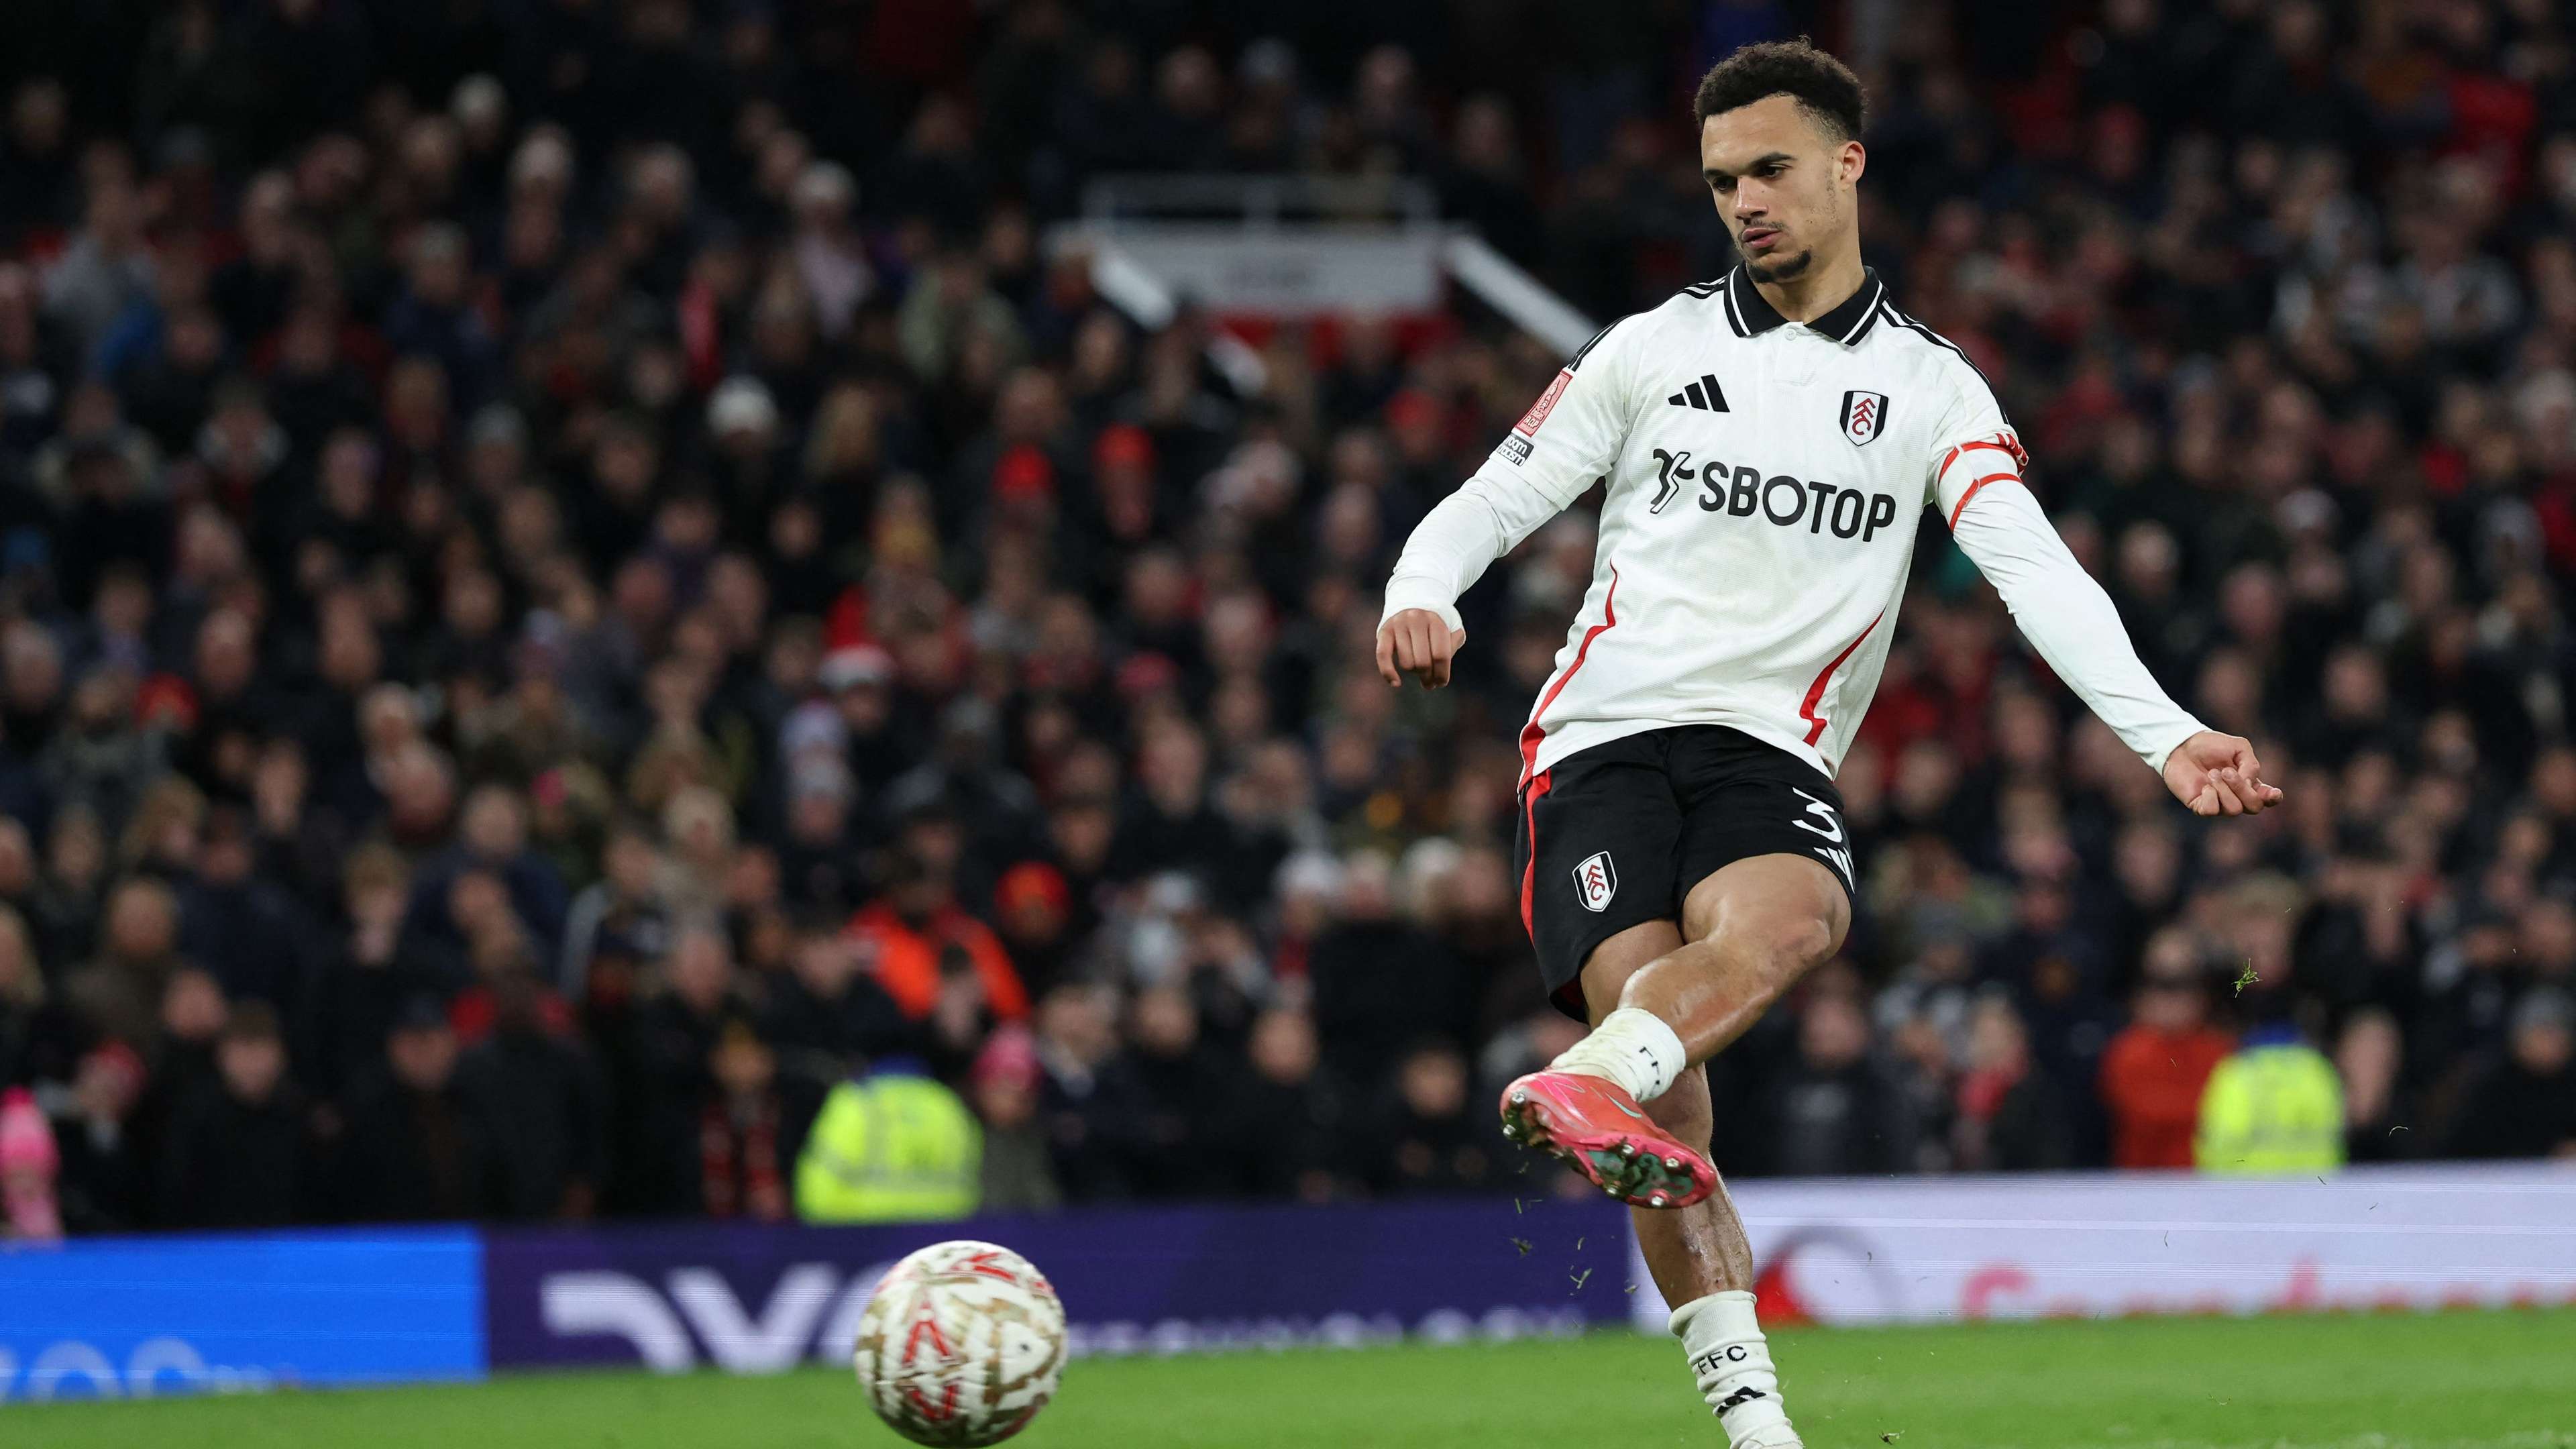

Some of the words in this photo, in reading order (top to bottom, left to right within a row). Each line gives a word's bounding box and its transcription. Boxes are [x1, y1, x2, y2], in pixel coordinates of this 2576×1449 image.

[1852, 398, 1876, 435] FFC
[1699, 461, 1896, 543] SBOTOP
[1792, 786, 1843, 843] 3
[1585, 864, 1605, 901] FFC
[1698, 1346, 1747, 1375] FFC
